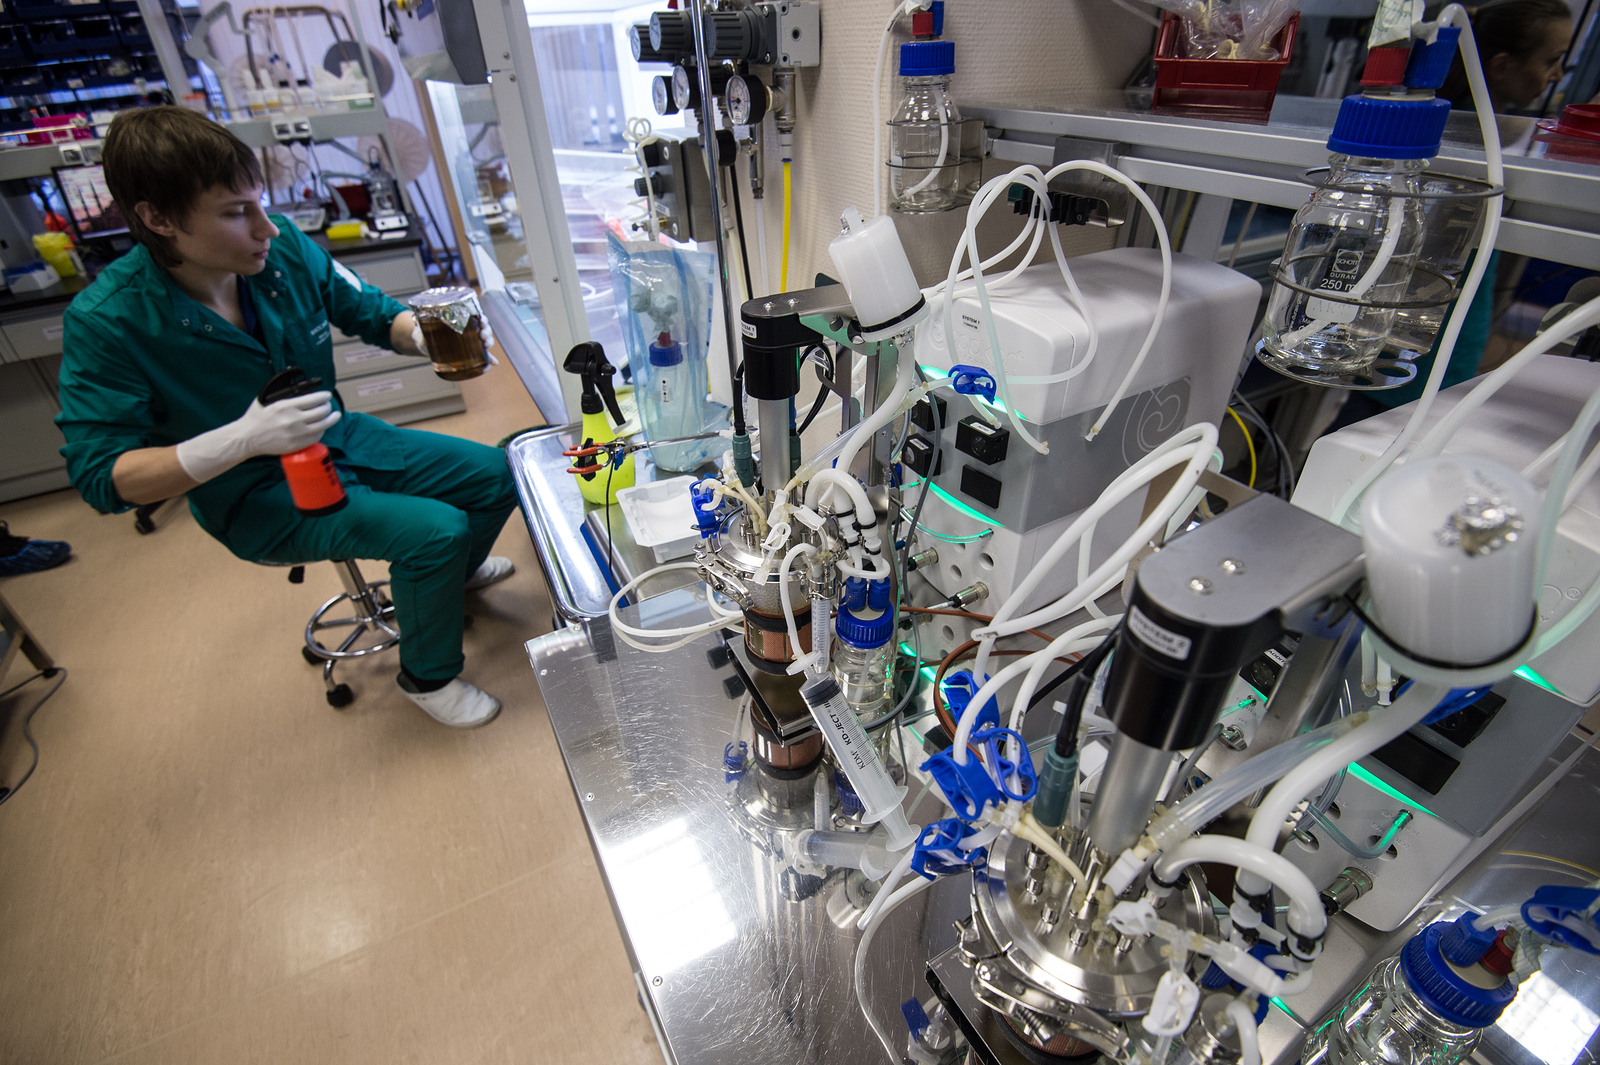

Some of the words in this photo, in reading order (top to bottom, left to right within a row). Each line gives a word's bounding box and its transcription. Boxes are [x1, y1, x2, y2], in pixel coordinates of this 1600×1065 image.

[1336, 258, 1359, 266] SCHOTT
[1330, 272, 1357, 280] DURAN
[1320, 278, 1343, 290] 250
